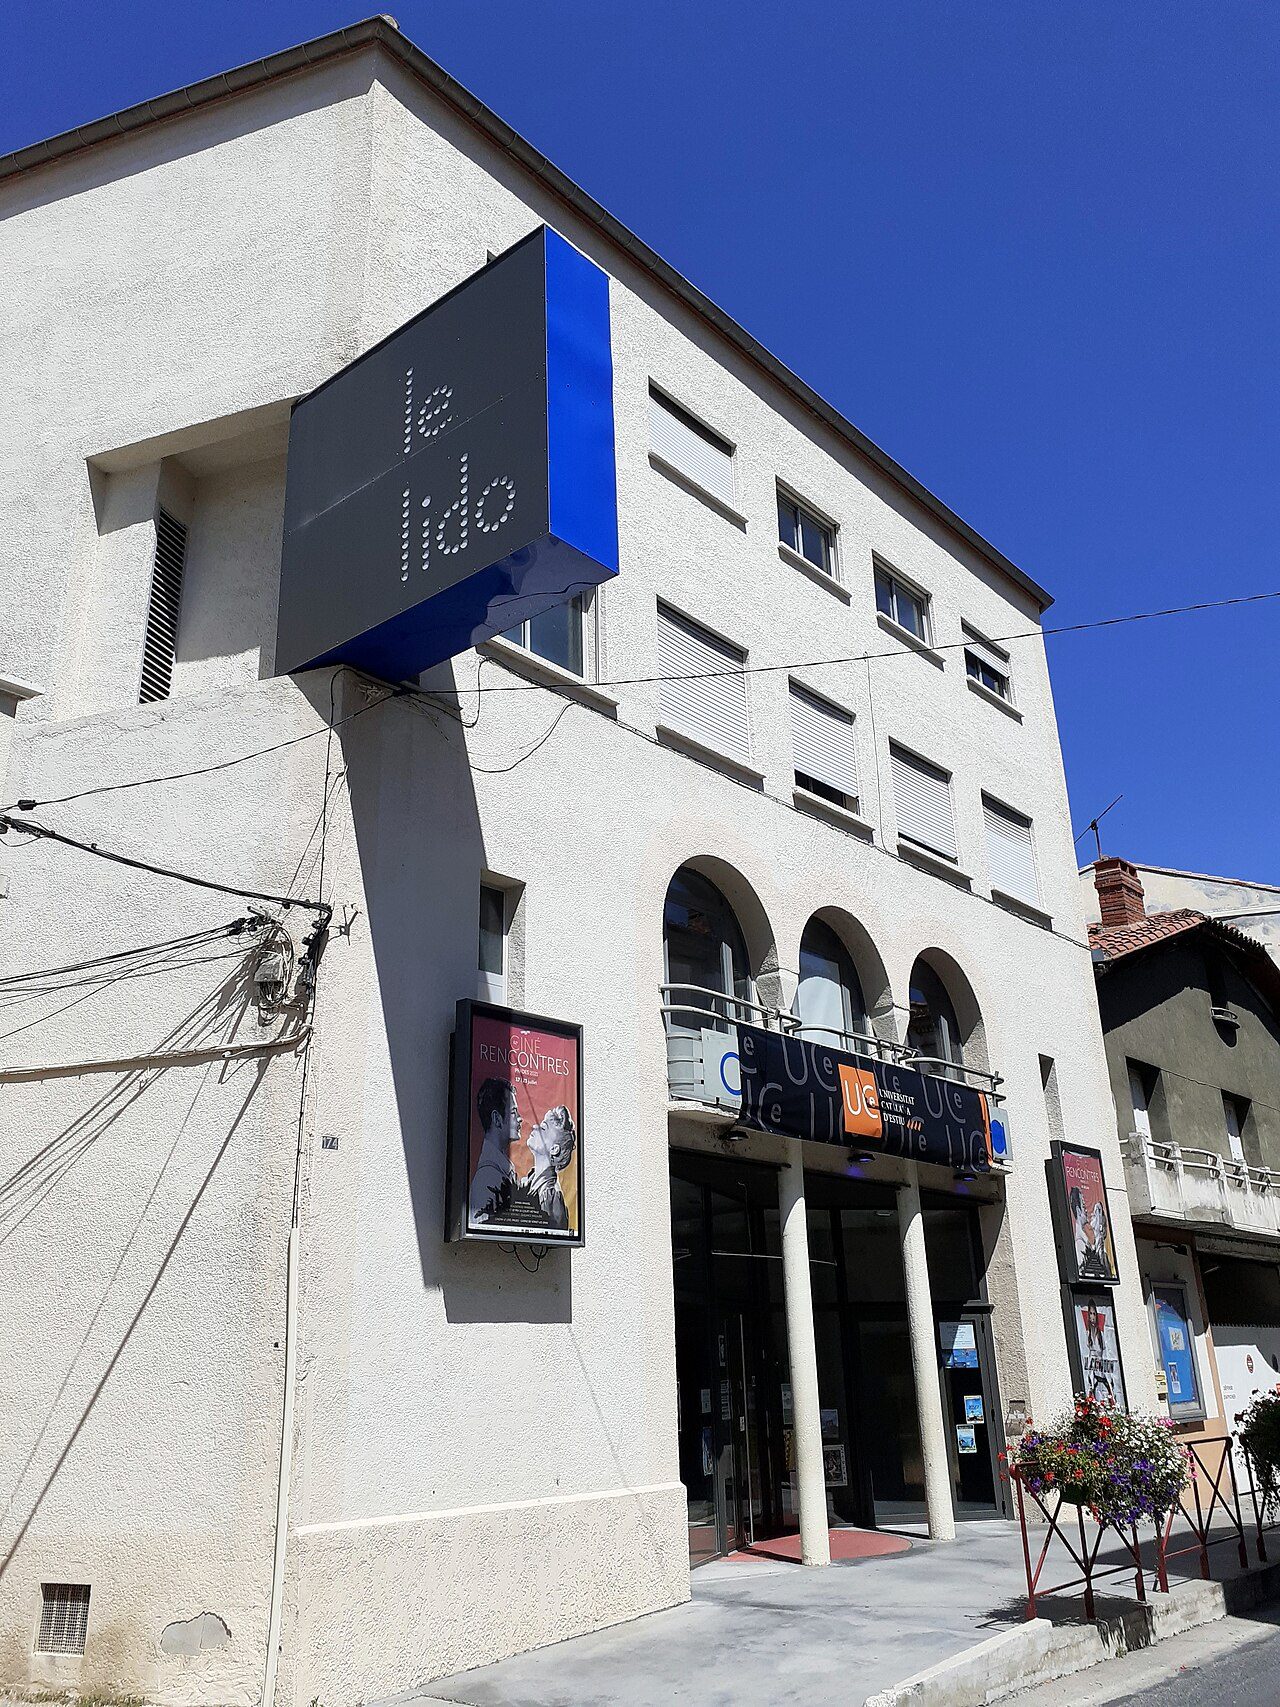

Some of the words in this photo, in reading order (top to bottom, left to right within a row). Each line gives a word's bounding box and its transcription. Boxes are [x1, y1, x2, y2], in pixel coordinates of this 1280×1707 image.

[403, 367, 453, 454] le
[401, 453, 517, 582] lido
[480, 1044, 569, 1076] RENCONTRES
[510, 1035, 541, 1054] CINÉ
[879, 1089, 915, 1105] UNIVERSITAT
